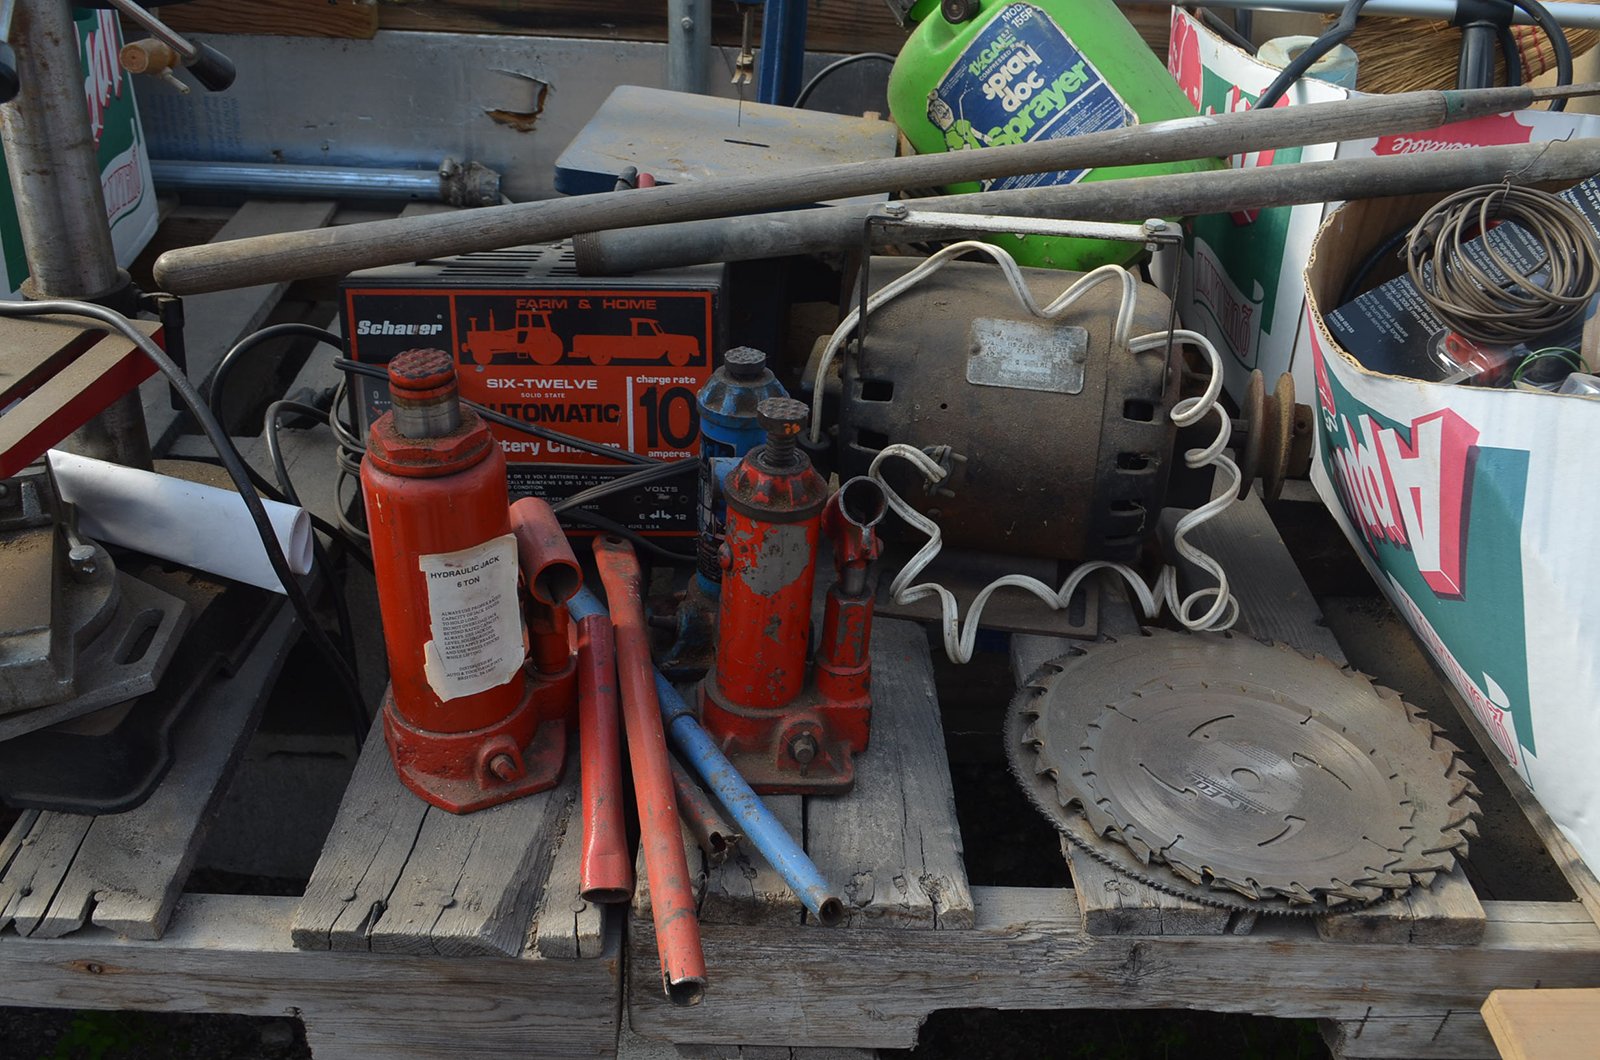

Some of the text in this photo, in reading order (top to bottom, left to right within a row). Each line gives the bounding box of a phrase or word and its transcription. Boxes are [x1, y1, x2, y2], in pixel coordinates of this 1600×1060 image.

[1011, 8, 1033, 28] 155P
[979, 49, 1012, 81] COMPRESSED
[982, 44, 1043, 100] spray
[1002, 70, 1045, 112] doc
[986, 60, 1089, 146] Sprayer
[516, 300, 657, 310] FARM & HOME
[357, 320, 443, 336] Schauer
[486, 378, 598, 390] SIX-TWELVE
[636, 374, 696, 385] charge rate
[482, 402, 620, 422] UTOMATIC
[639, 386, 700, 450] 10
[648, 450, 692, 460] amperes
[430, 556, 500, 579] HYDRAULIC JACK
[464, 576, 480, 586] TON
